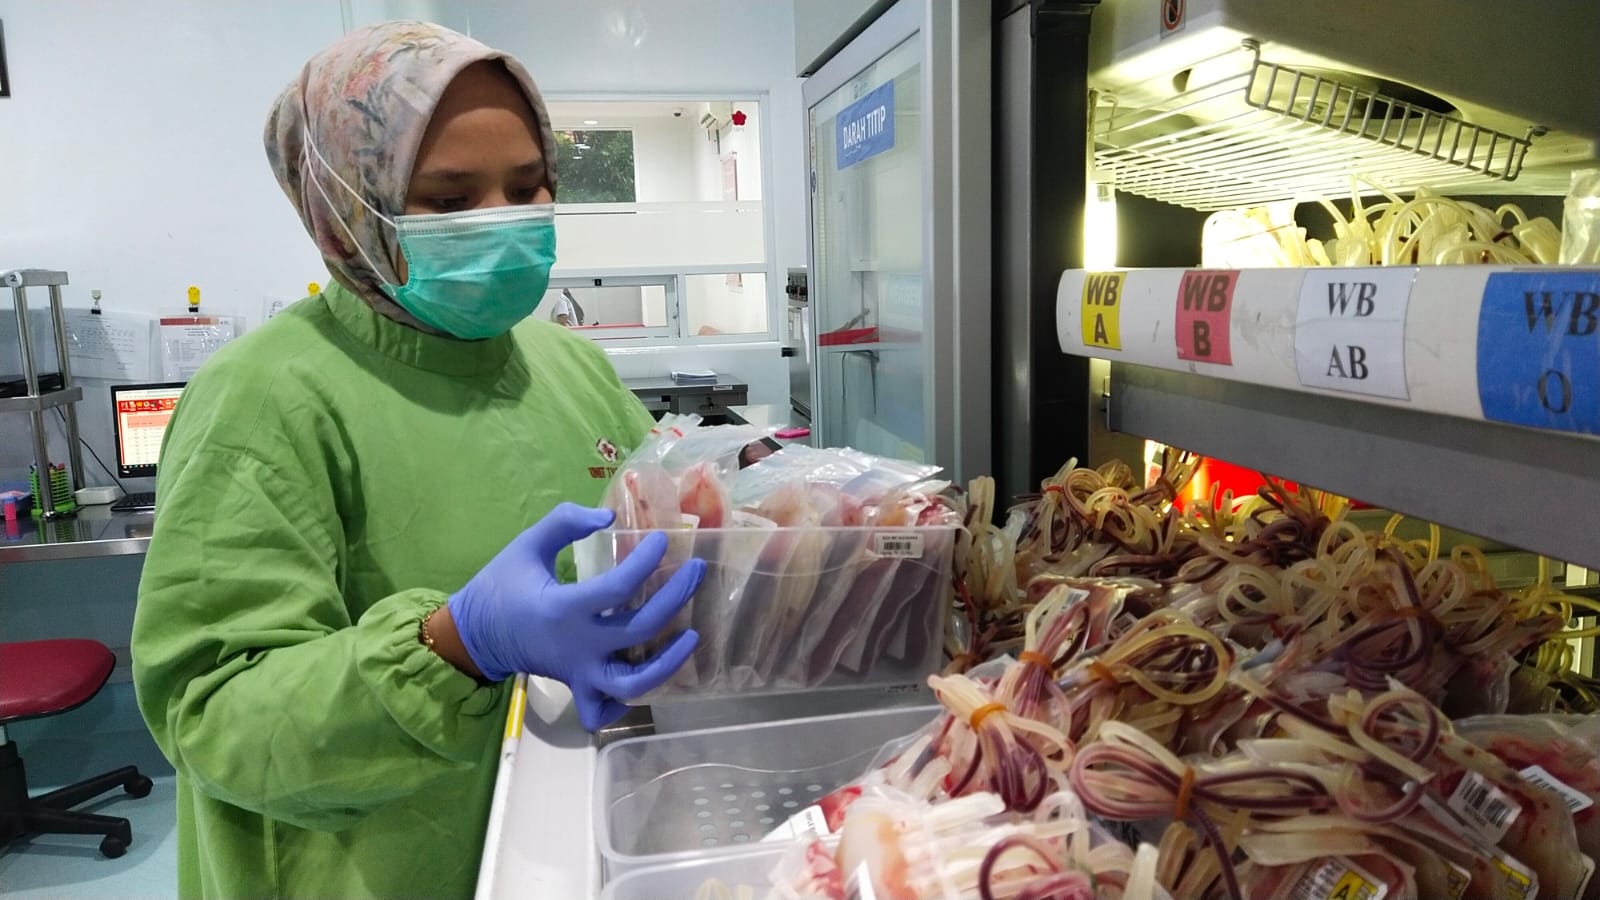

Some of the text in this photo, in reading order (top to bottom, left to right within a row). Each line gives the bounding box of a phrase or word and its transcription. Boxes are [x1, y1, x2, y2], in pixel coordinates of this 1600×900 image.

[843, 105, 886, 150] DARAH TITIP
[10, 274, 17, 282] 2
[1087, 275, 1120, 306] WB
[1183, 275, 1230, 312] WB
[1327, 282, 1377, 317] WB
[1523, 291, 1600, 337] WB
[1094, 313, 1109, 344] A
[1193, 320, 1211, 357] B
[1327, 344, 1369, 380] AB
[1536, 368, 1572, 414] O
